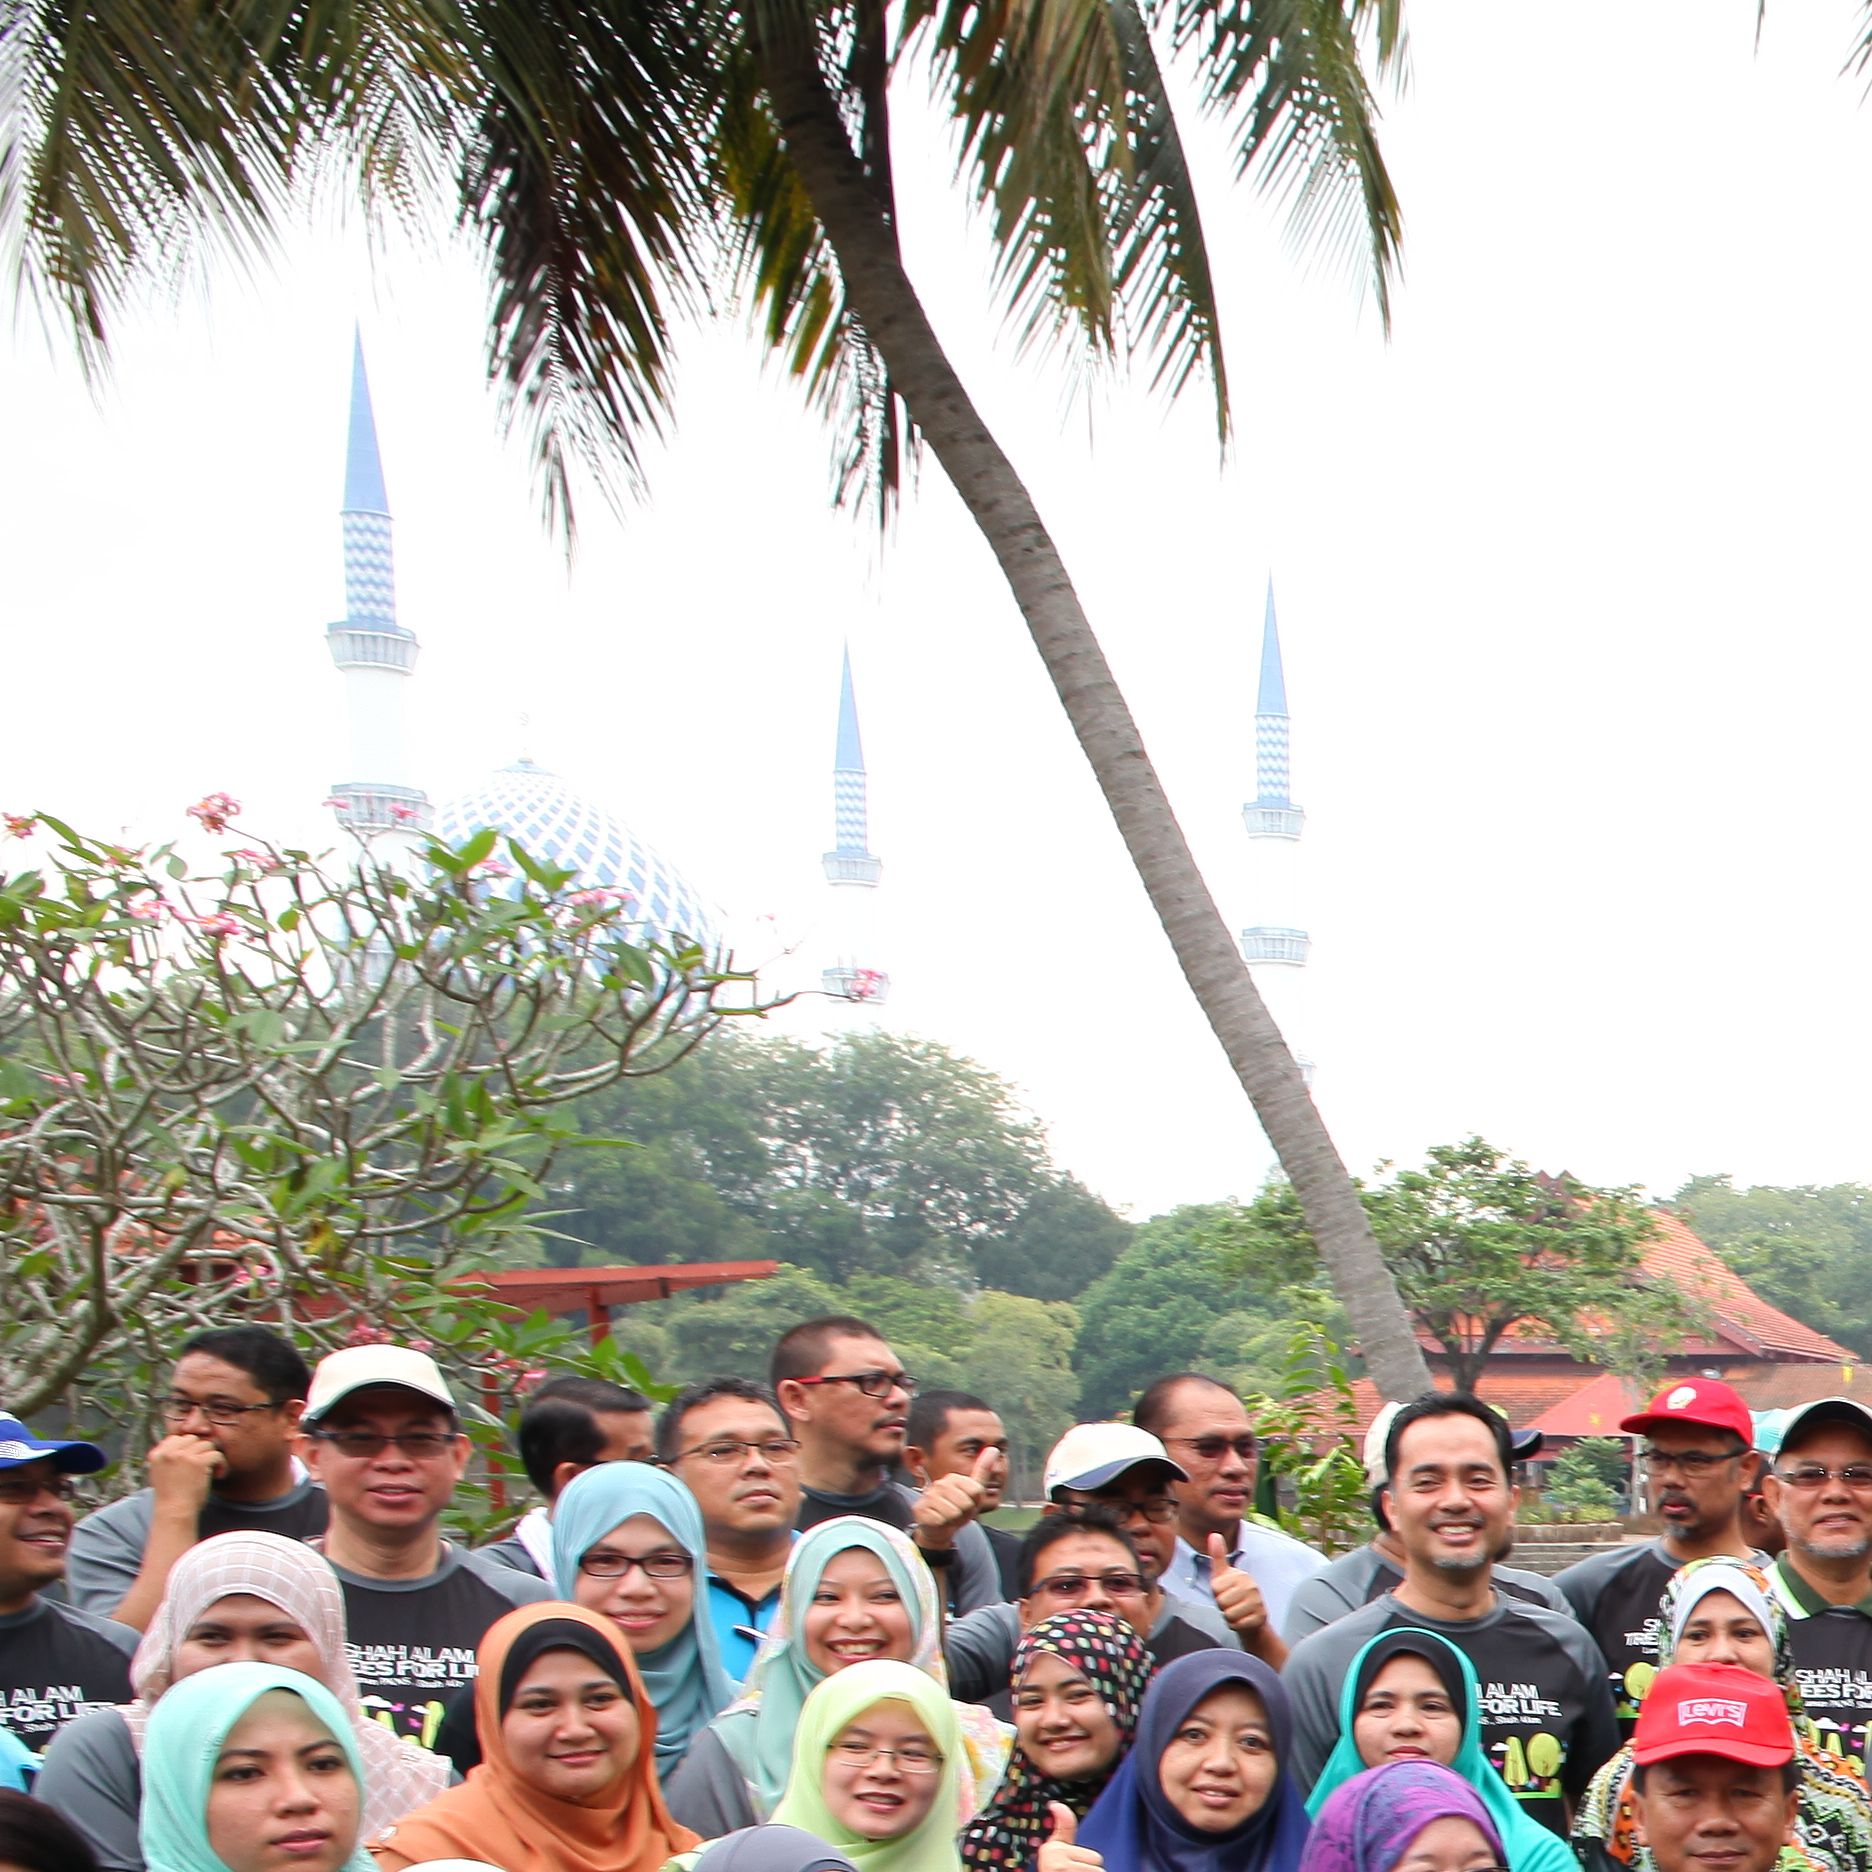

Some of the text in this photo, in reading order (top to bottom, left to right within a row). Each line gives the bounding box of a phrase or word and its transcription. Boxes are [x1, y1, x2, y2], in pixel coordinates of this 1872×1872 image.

[409, 1645, 475, 1664] ALAM
[395, 1659, 448, 1679] FOR
[9, 1684, 84, 1707] ALAM
[1485, 1681, 1540, 1700] ALAM
[1520, 1699, 1564, 1717] LIFE
